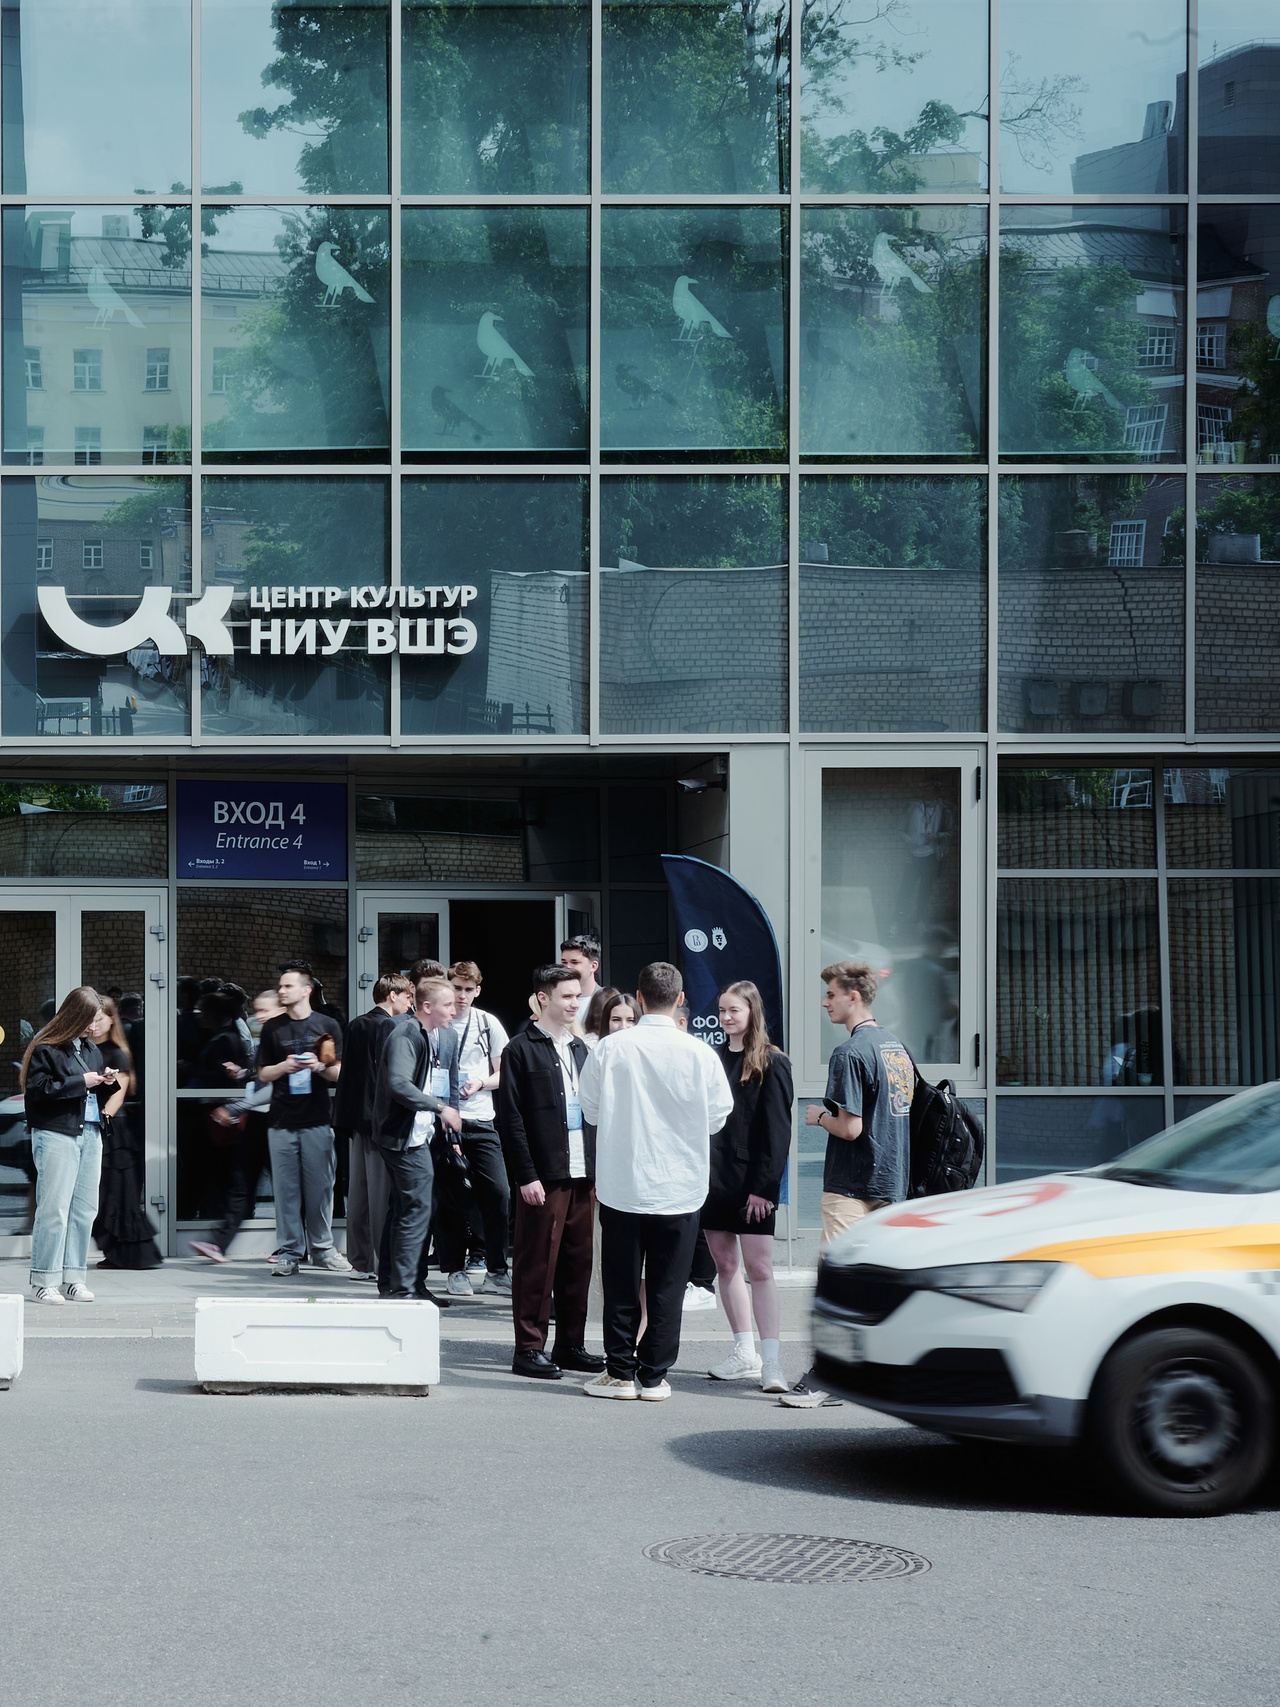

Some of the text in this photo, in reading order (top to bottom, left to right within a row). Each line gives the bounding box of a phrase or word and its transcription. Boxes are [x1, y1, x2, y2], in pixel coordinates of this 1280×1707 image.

[249, 585, 478, 612] ЦЕНТР КУЛЬТУР
[249, 617, 478, 655] НИУ ВШЭ
[214, 801, 306, 830] ВХОД 4
[216, 832, 303, 849] Entrance 4
